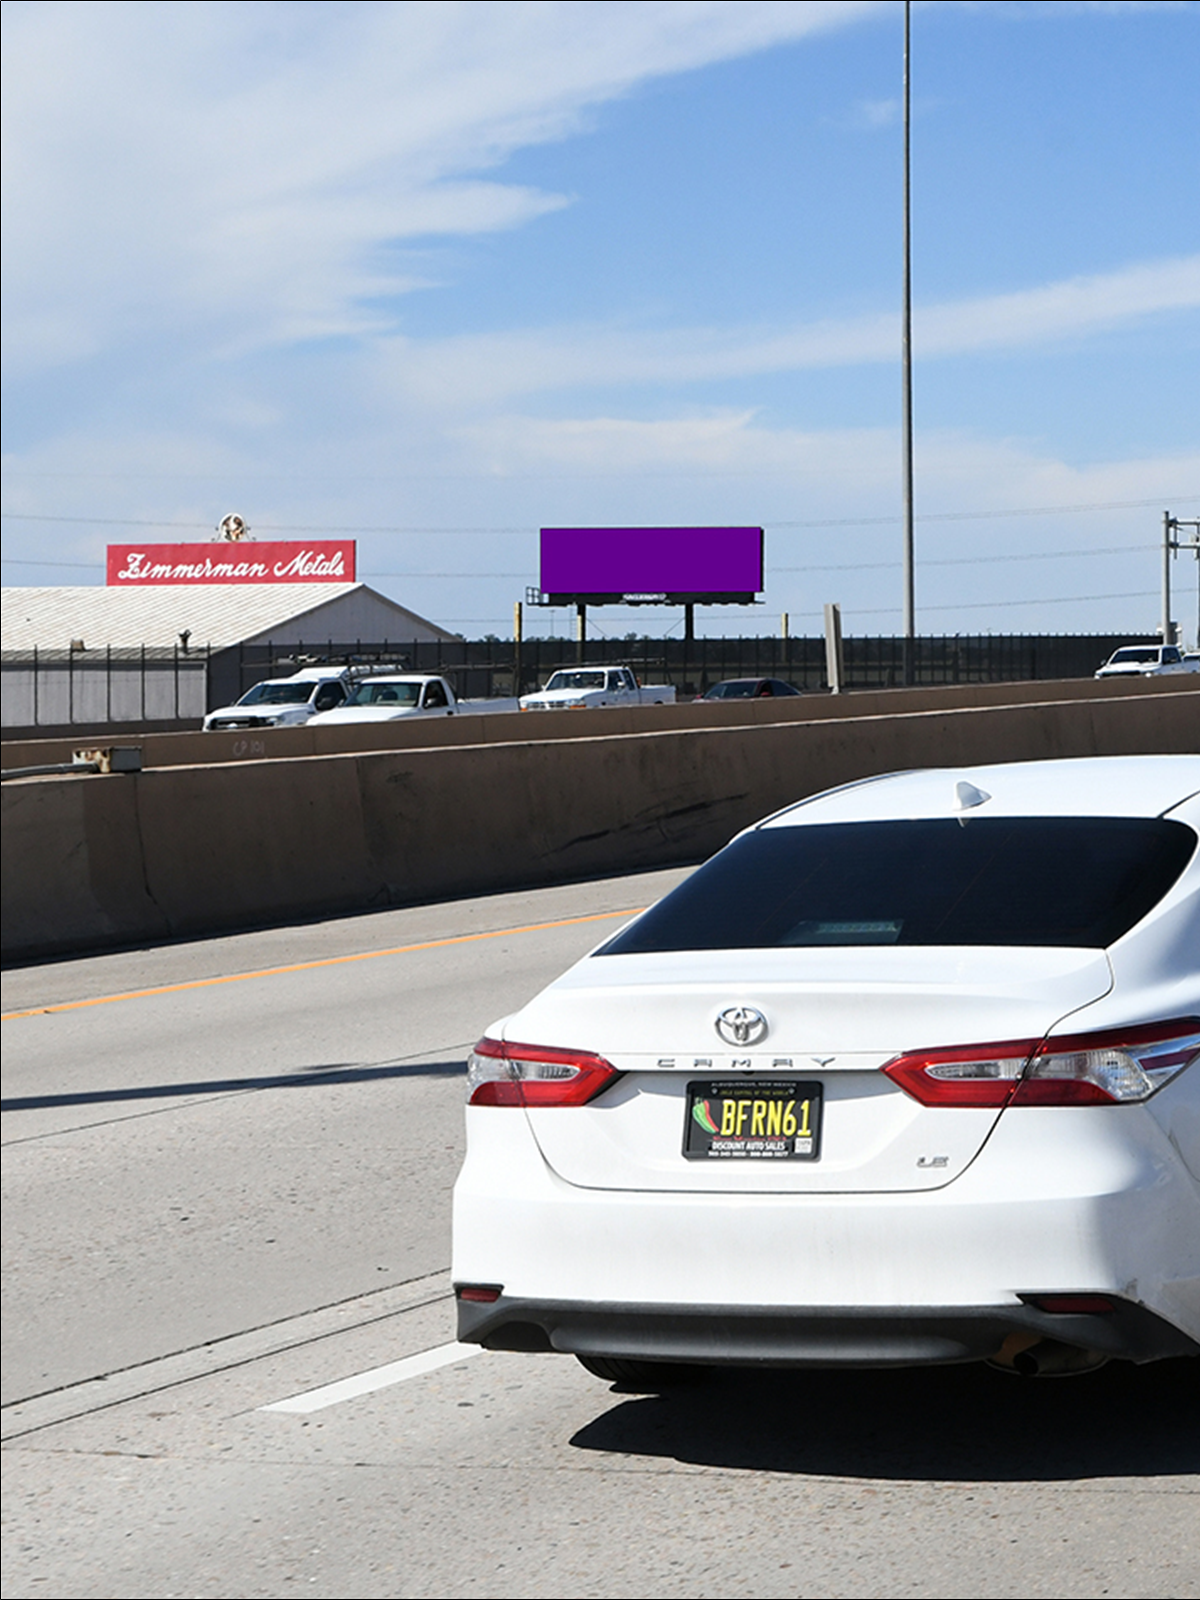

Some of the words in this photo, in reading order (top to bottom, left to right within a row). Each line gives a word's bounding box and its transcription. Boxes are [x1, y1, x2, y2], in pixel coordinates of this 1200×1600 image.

[117, 552, 270, 580] Zimmerman
[272, 550, 345, 577] Metals
[657, 1057, 836, 1069] CAMRY
[721, 1099, 811, 1136] BFRN61
[712, 1140, 745, 1151] DISCOUNT
[746, 1140, 764, 1151] AUTO
[764, 1140, 786, 1151] SALES
[916, 1156, 949, 1169] LE
